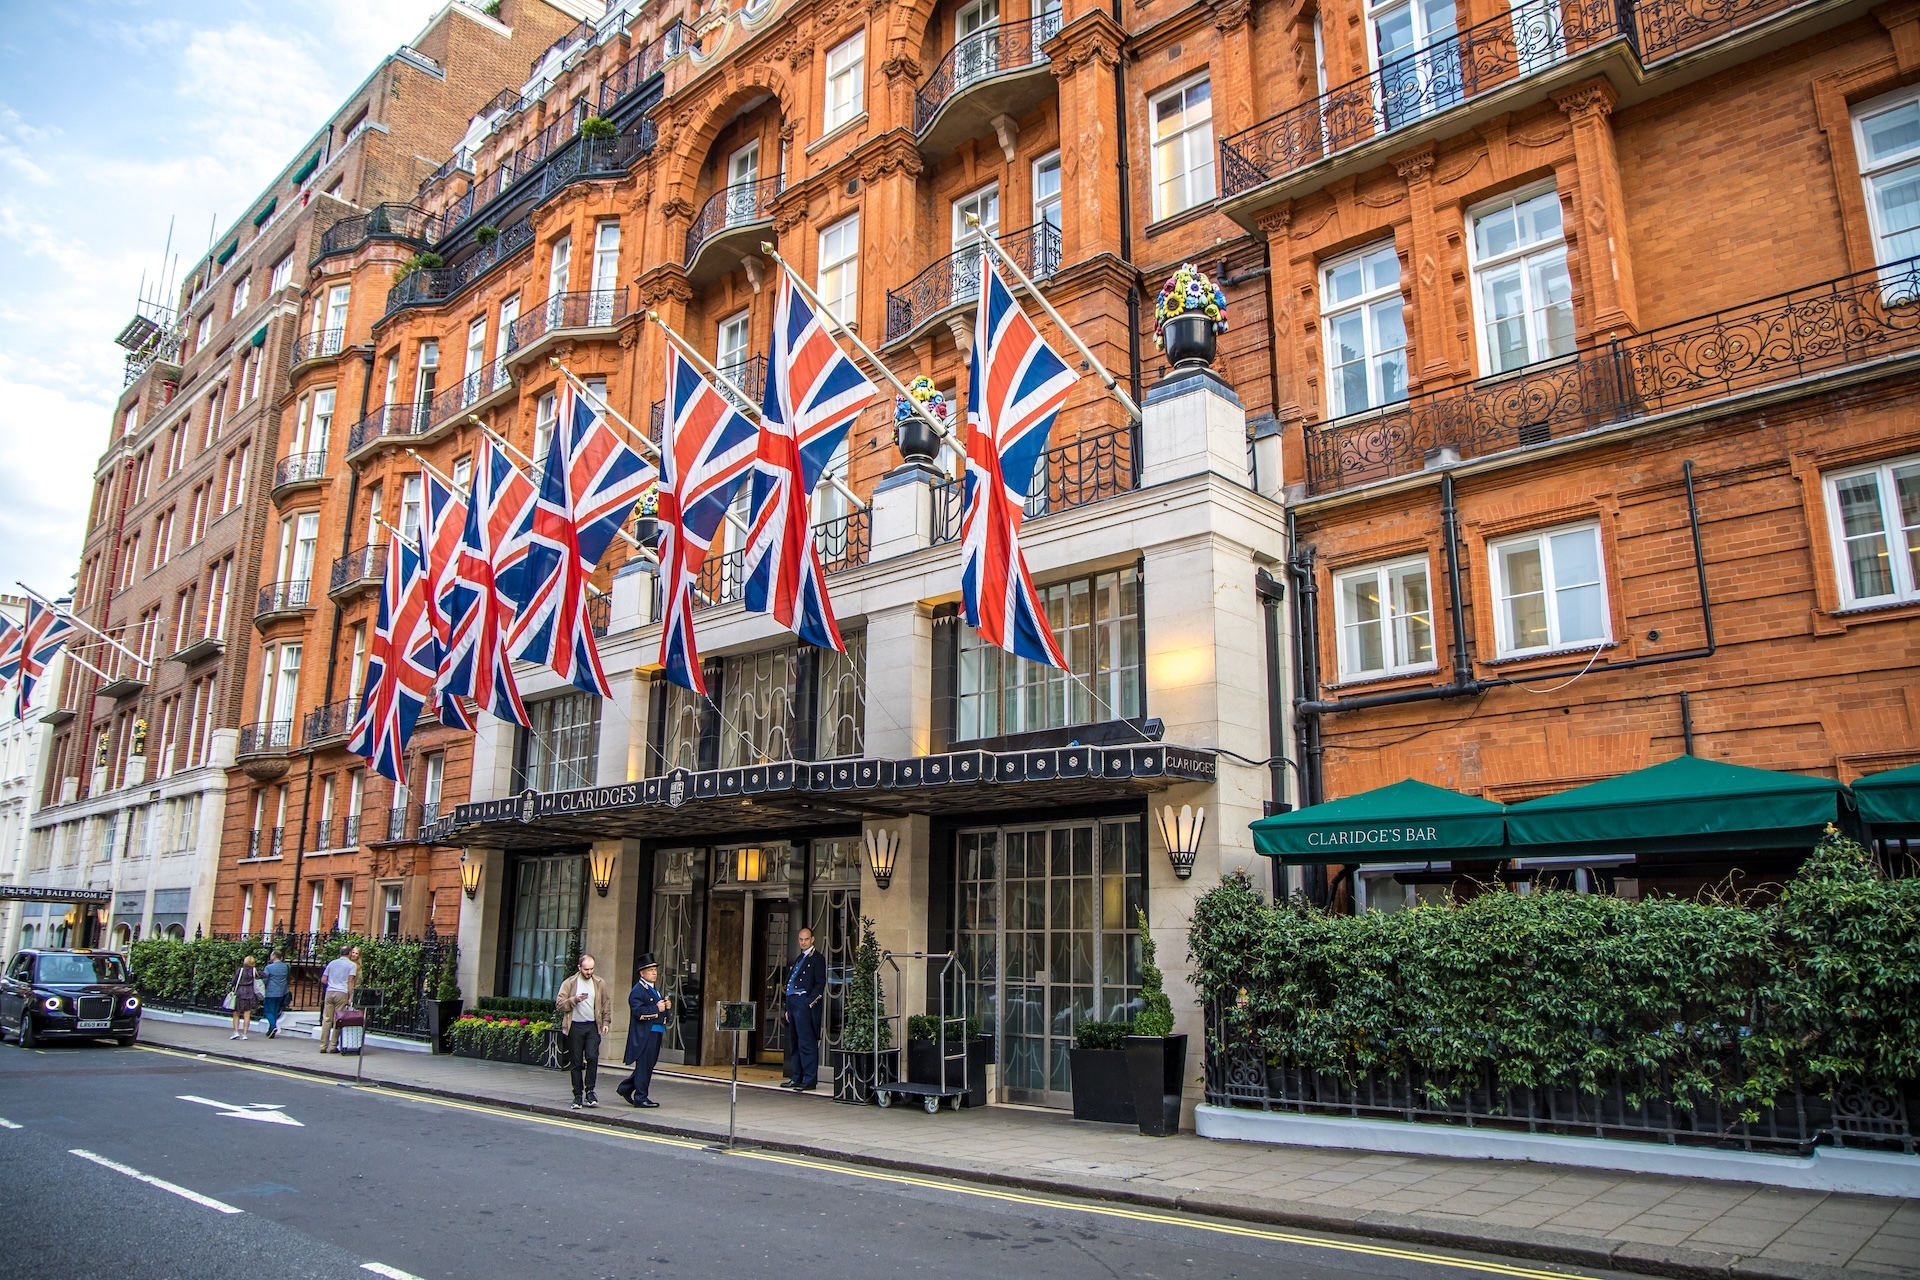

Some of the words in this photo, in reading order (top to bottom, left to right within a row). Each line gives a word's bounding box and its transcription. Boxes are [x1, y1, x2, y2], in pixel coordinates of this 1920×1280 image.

[560, 785, 636, 810] CLARIDGE'S
[1307, 828, 1401, 846] CLARIDGE'S
[1406, 827, 1437, 841] BAR
[46, 889, 70, 897] BALL
[70, 890, 98, 898] ROOM
